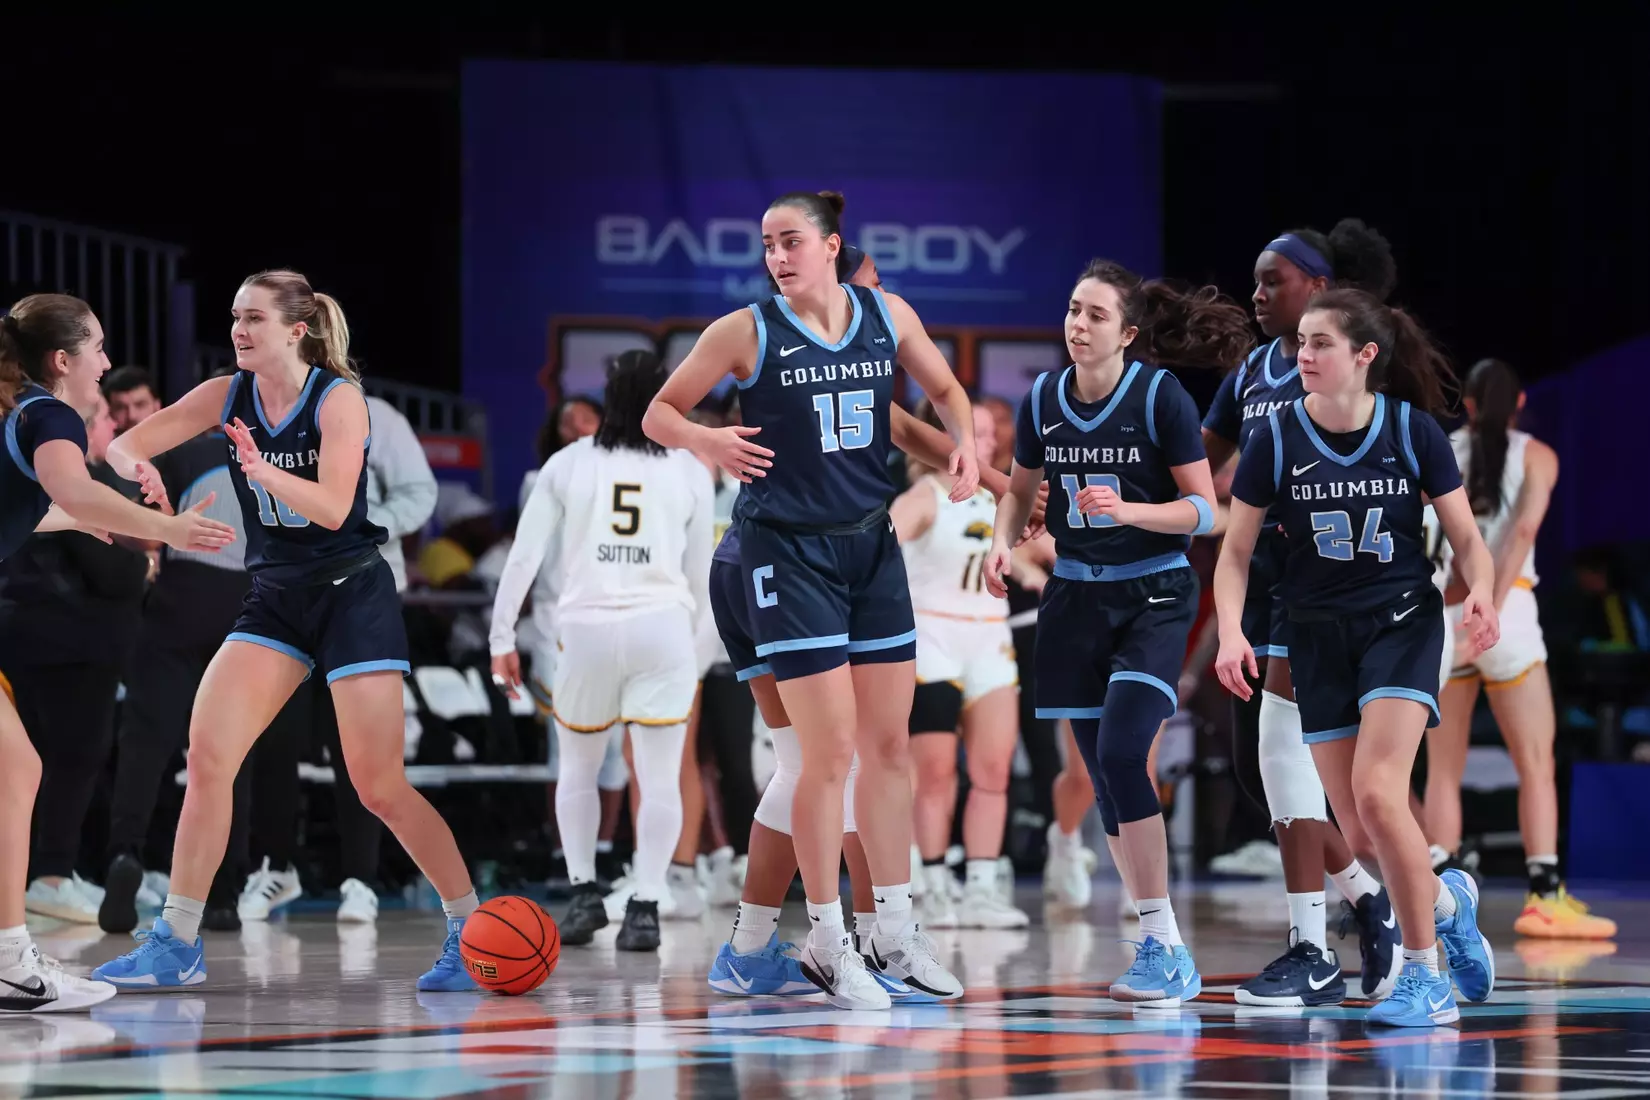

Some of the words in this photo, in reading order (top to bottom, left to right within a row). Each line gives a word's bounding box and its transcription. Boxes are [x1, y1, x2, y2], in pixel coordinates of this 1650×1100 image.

[860, 222, 1026, 274] BOY
[780, 360, 892, 386] COLUMBIA
[812, 389, 874, 453] 15
[228, 444, 319, 469] CMBIA
[1045, 446, 1141, 463] COLUMBIA
[1291, 478, 1409, 500] COLUMBIA
[611, 482, 642, 537] 5
[1310, 507, 1395, 563] 24
[597, 543, 651, 564] SUTTON
[752, 565, 779, 609] C
